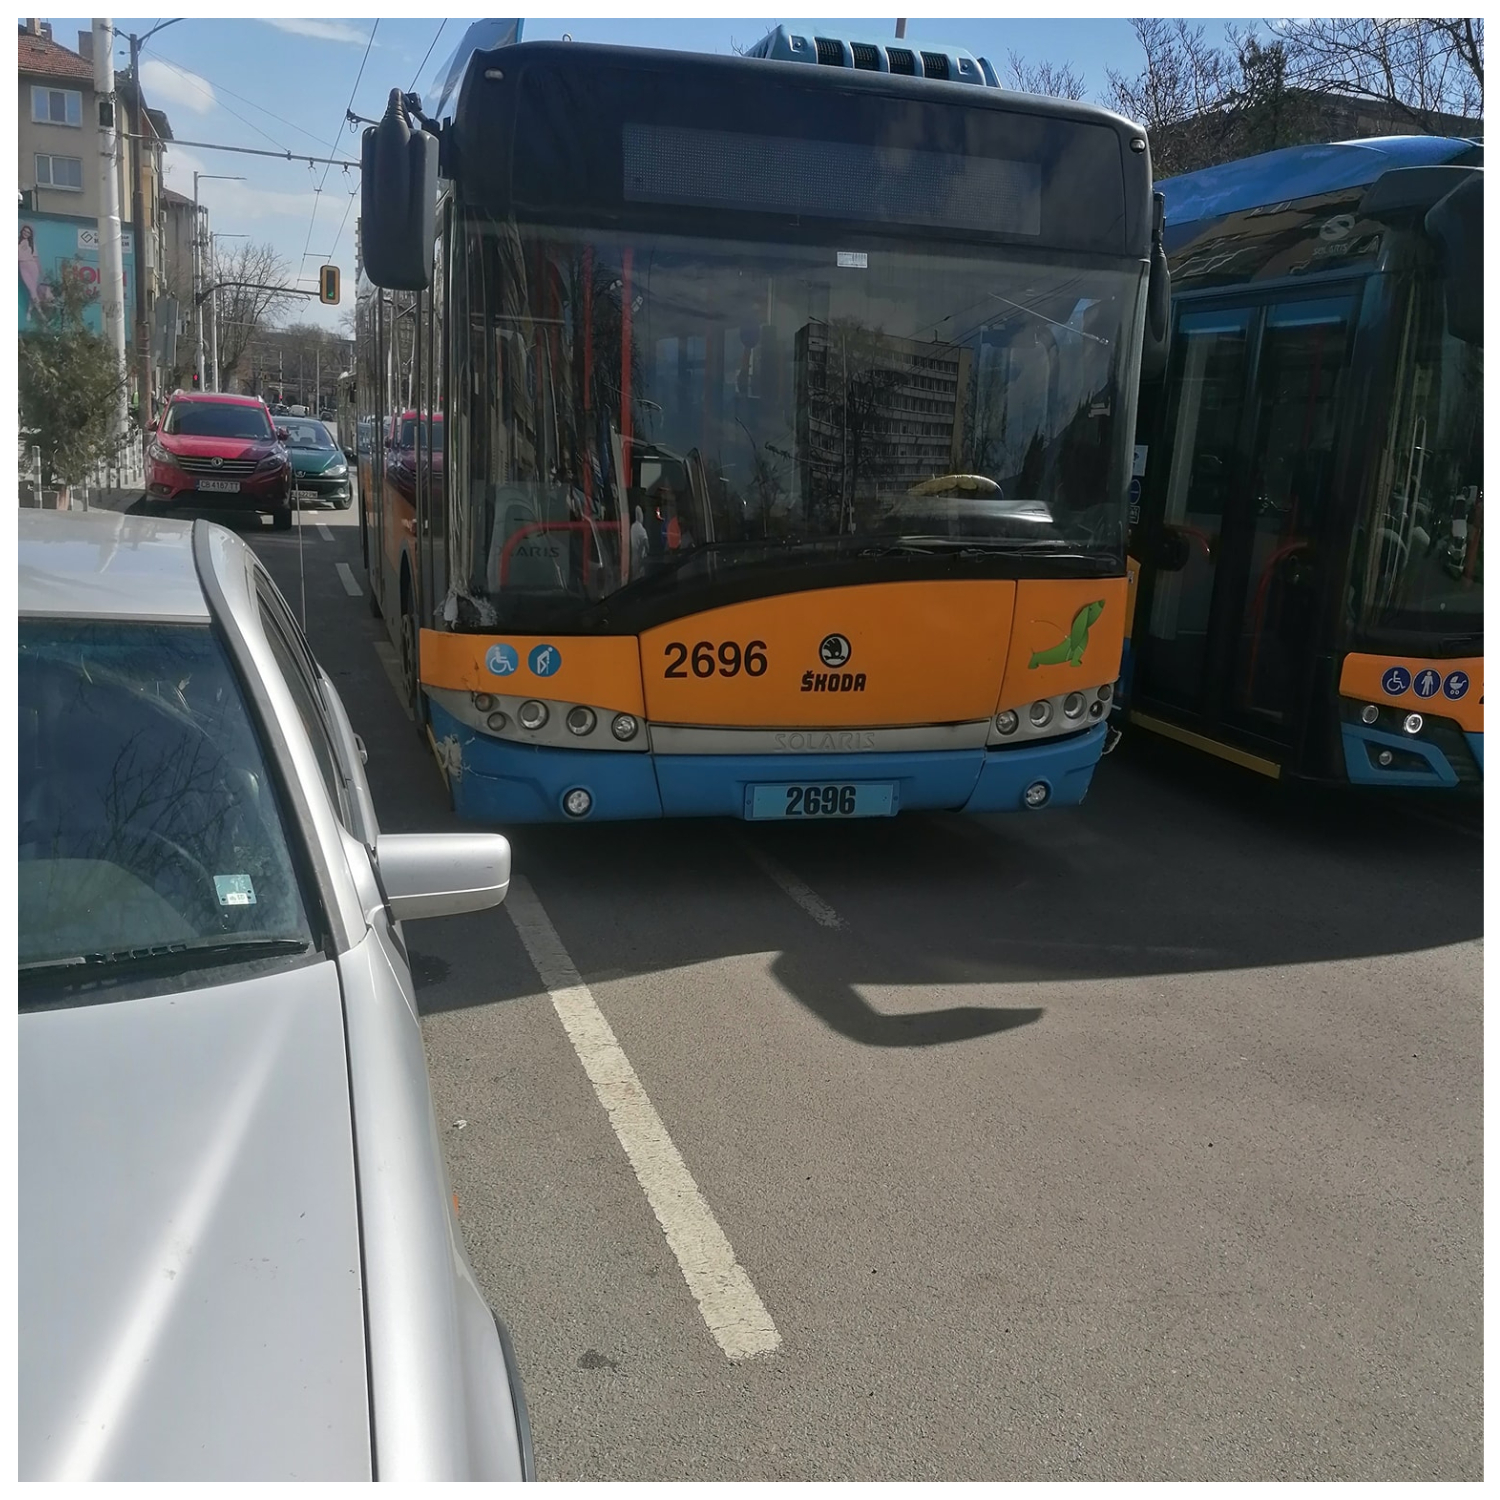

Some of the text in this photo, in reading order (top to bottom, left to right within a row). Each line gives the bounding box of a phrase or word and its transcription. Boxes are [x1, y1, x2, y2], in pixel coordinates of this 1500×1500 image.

[664, 640, 768, 678] 2696
[800, 670, 867, 692] ŠKODA
[774, 732, 875, 750] SOLARIS
[785, 786, 857, 815] 2696
